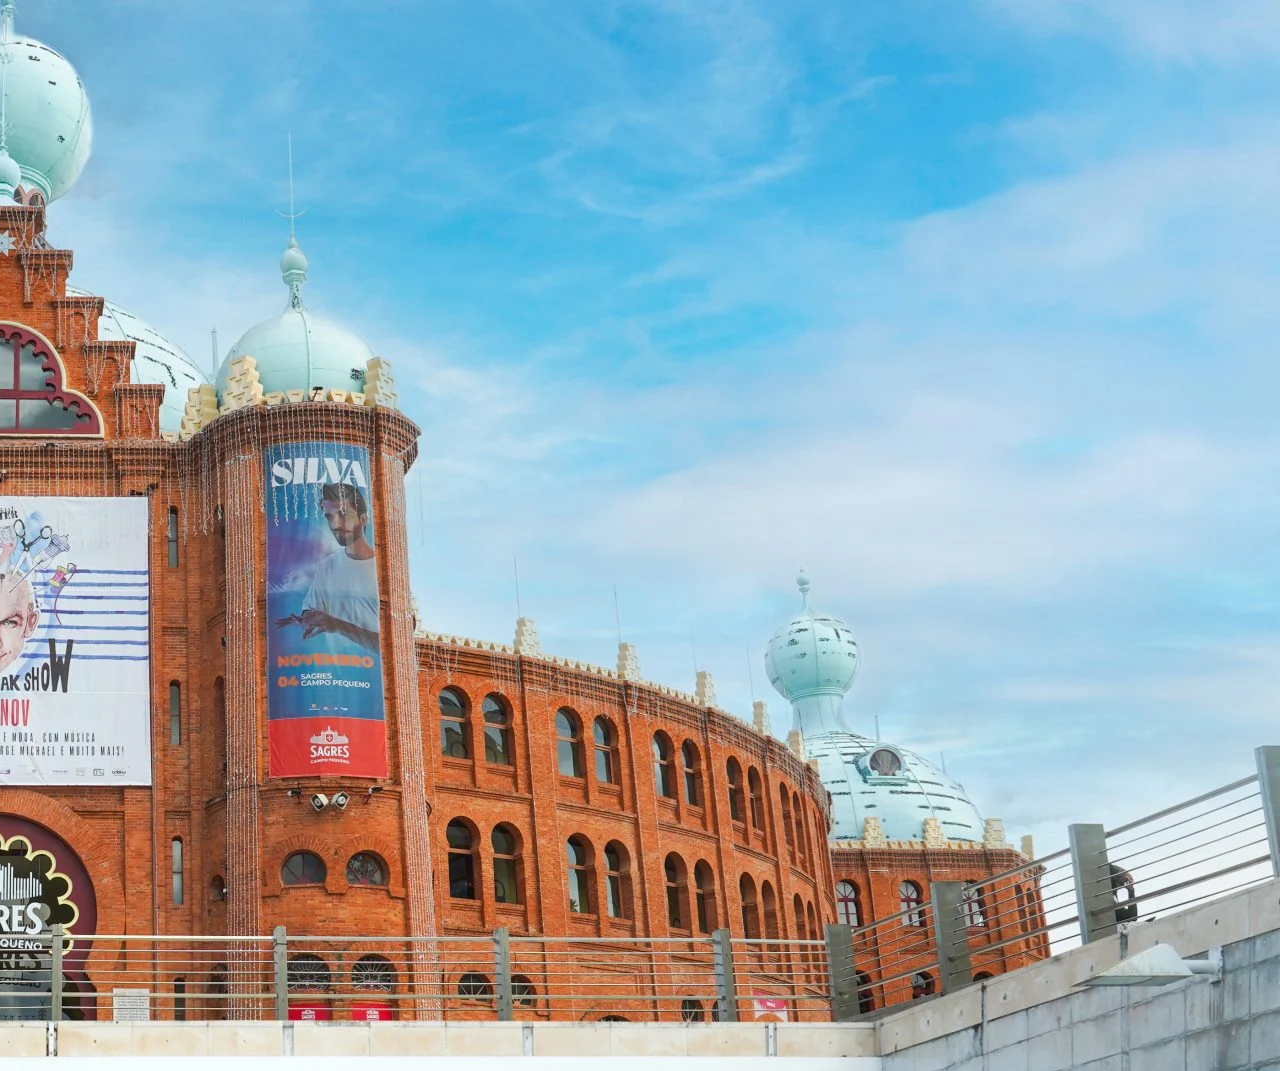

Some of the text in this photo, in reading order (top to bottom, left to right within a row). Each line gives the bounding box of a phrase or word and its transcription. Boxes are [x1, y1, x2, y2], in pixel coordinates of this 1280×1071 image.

[271, 457, 367, 488] SILVA
[23, 638, 74, 693] SHOW
[277, 653, 374, 669] NOVEMBRO
[277, 675, 300, 688] 04
[300, 679, 371, 689] CAMPO PEQUENO
[0, 698, 30, 727] NOV
[42, 732, 59, 743] COM
[20, 746, 55, 757] MICHAEL
[60, 746, 64, 756] E
[69, 746, 95, 757] MUITO
[100, 746, 125, 757] MAIS!
[310, 745, 350, 758] SAGRES
